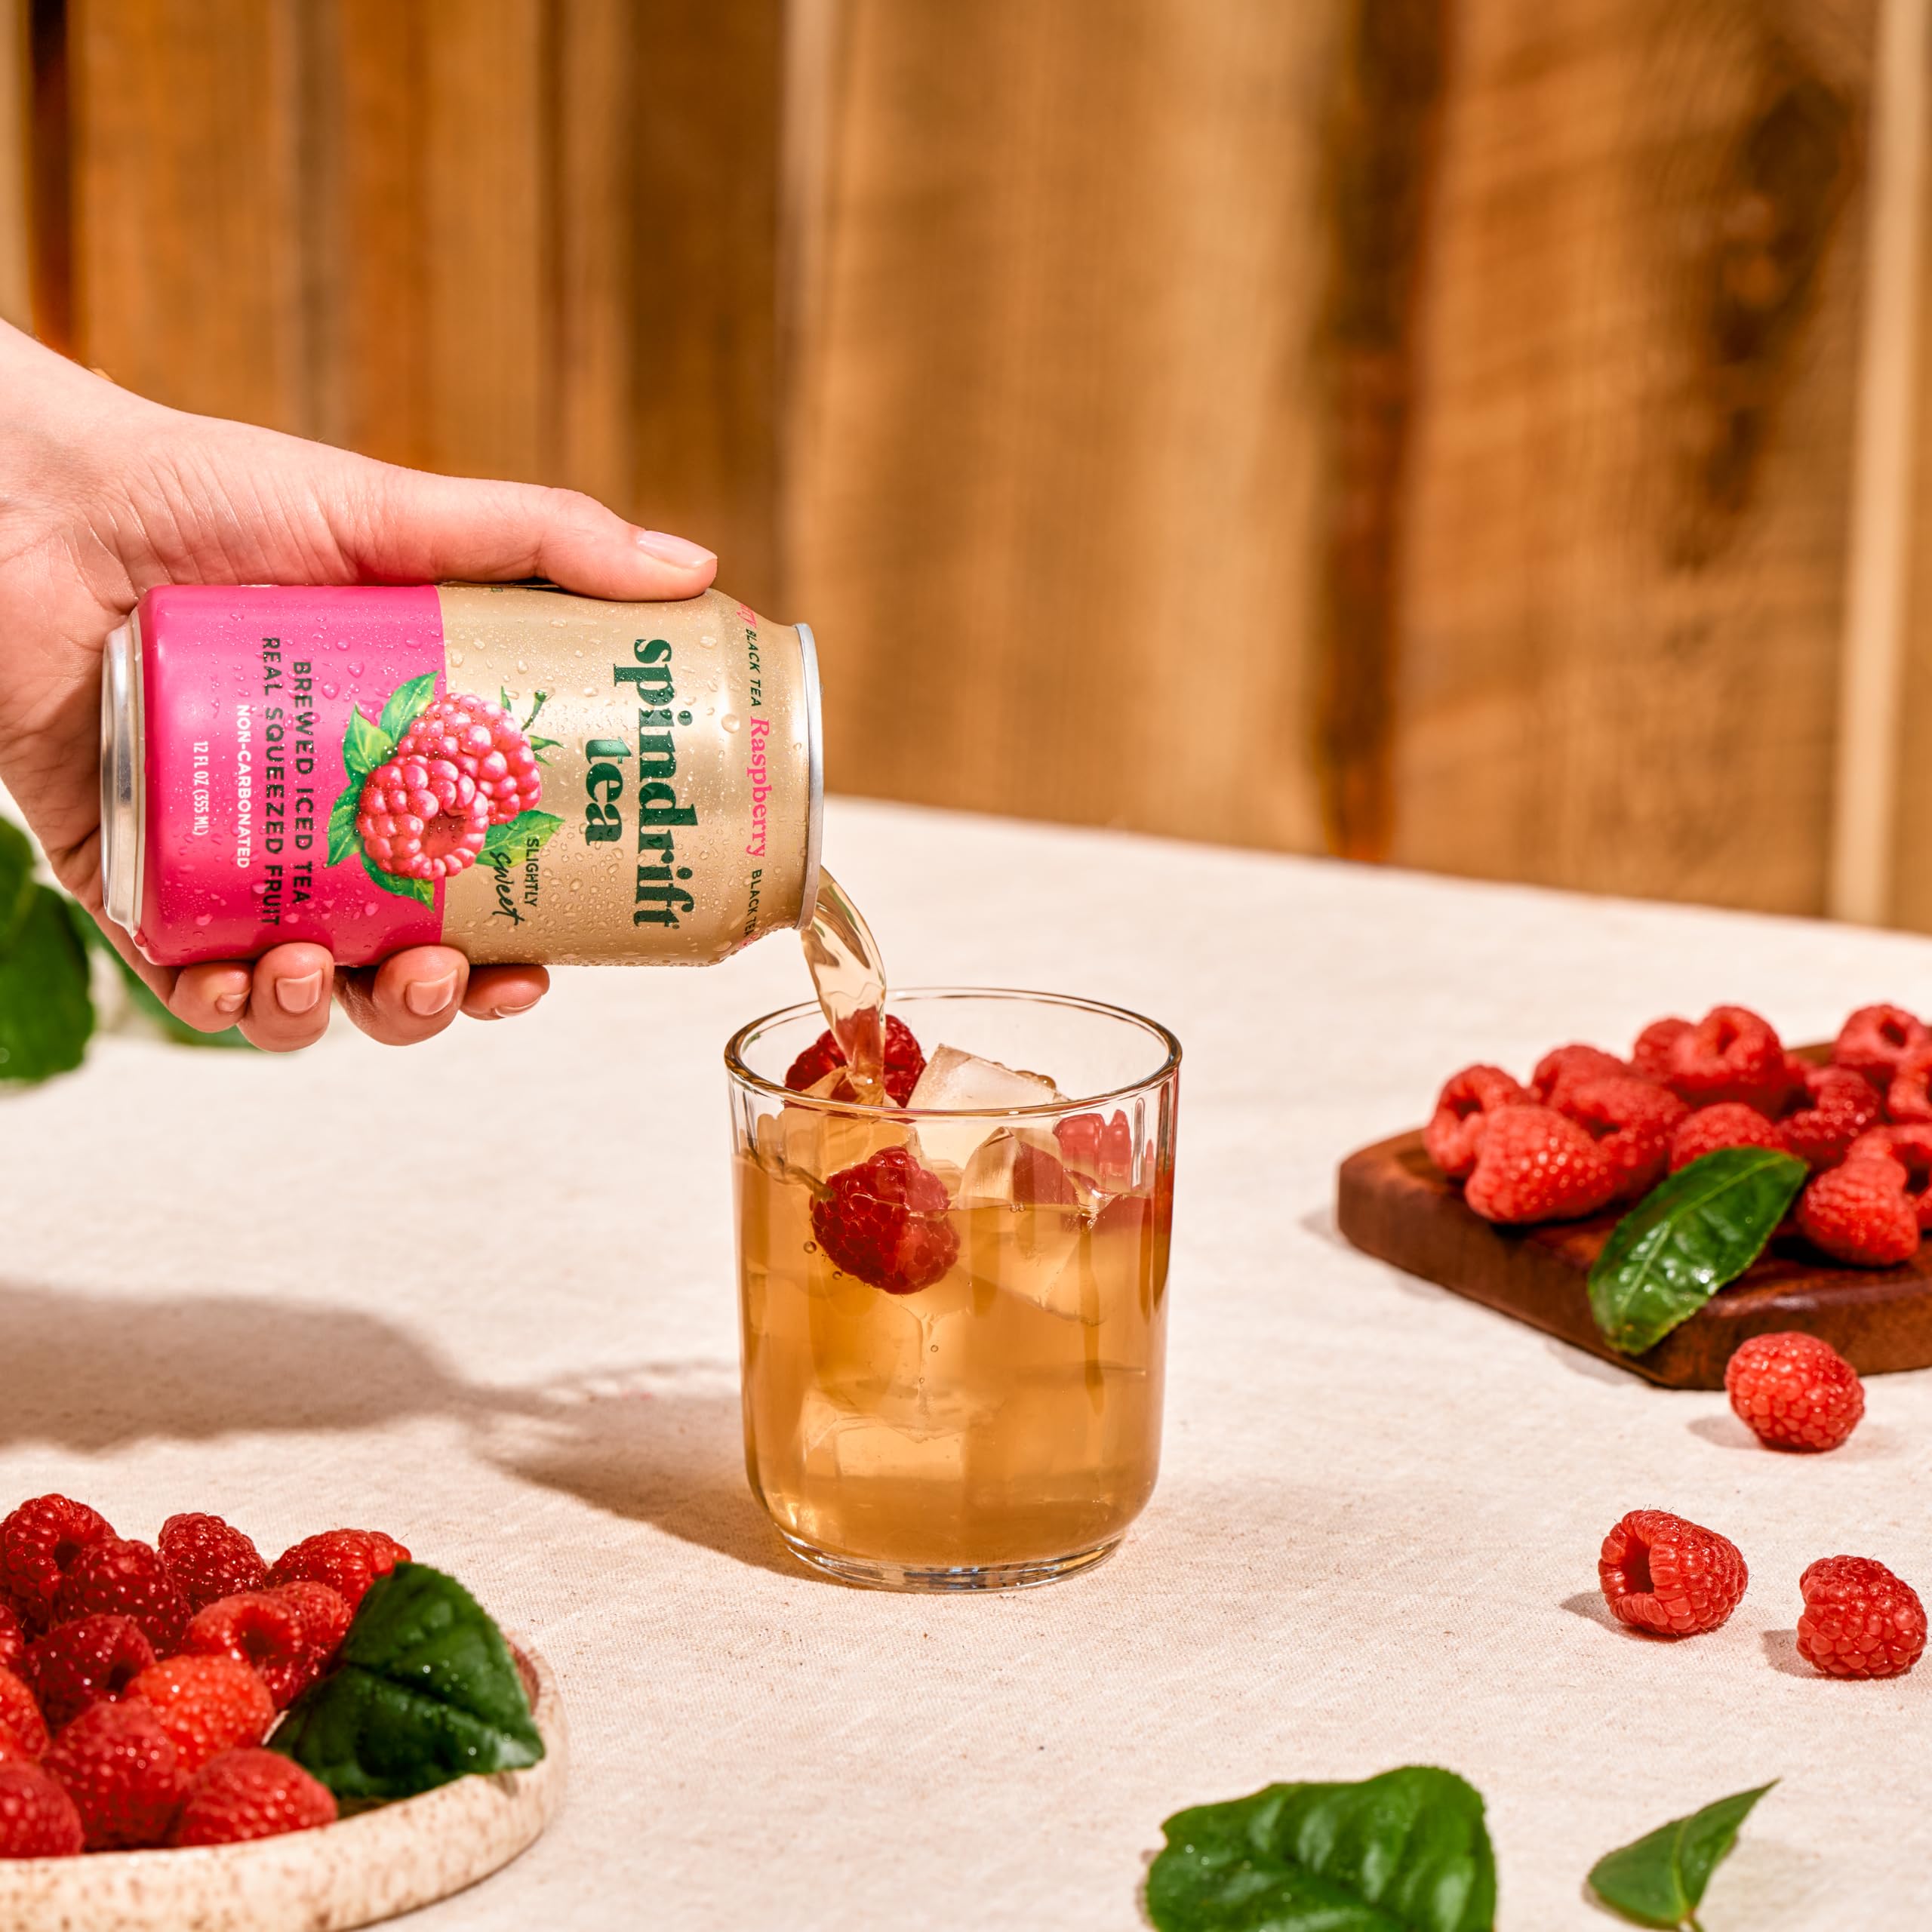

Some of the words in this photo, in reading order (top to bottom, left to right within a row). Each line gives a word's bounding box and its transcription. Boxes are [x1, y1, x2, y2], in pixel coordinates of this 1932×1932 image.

[263, 637, 282, 696] REAL
[746, 628, 761, 673] BLACK
[293, 662, 314, 774] BREWED
[749, 678, 761, 707] TEA
[193, 741, 208, 753] 12
[193, 755, 208, 768] FL
[192, 789, 209, 813] (355
[193, 771, 208, 785] OZ
[236, 704, 251, 869] NON-CARBONATED
[265, 707, 285, 854] SQUEEZED
[585, 737, 632, 846] tea
[614, 638, 698, 928] spindrift
[746, 716, 772, 857] Raspberry
[192, 815, 208, 836] ML)
[295, 789, 314, 851] ICED
[261, 865, 283, 926] FRUIT
[293, 861, 312, 903] TEA
[489, 851, 525, 926] sweet
[524, 838, 539, 907] SLIGHTLY
[747, 869, 762, 916] BLACK
